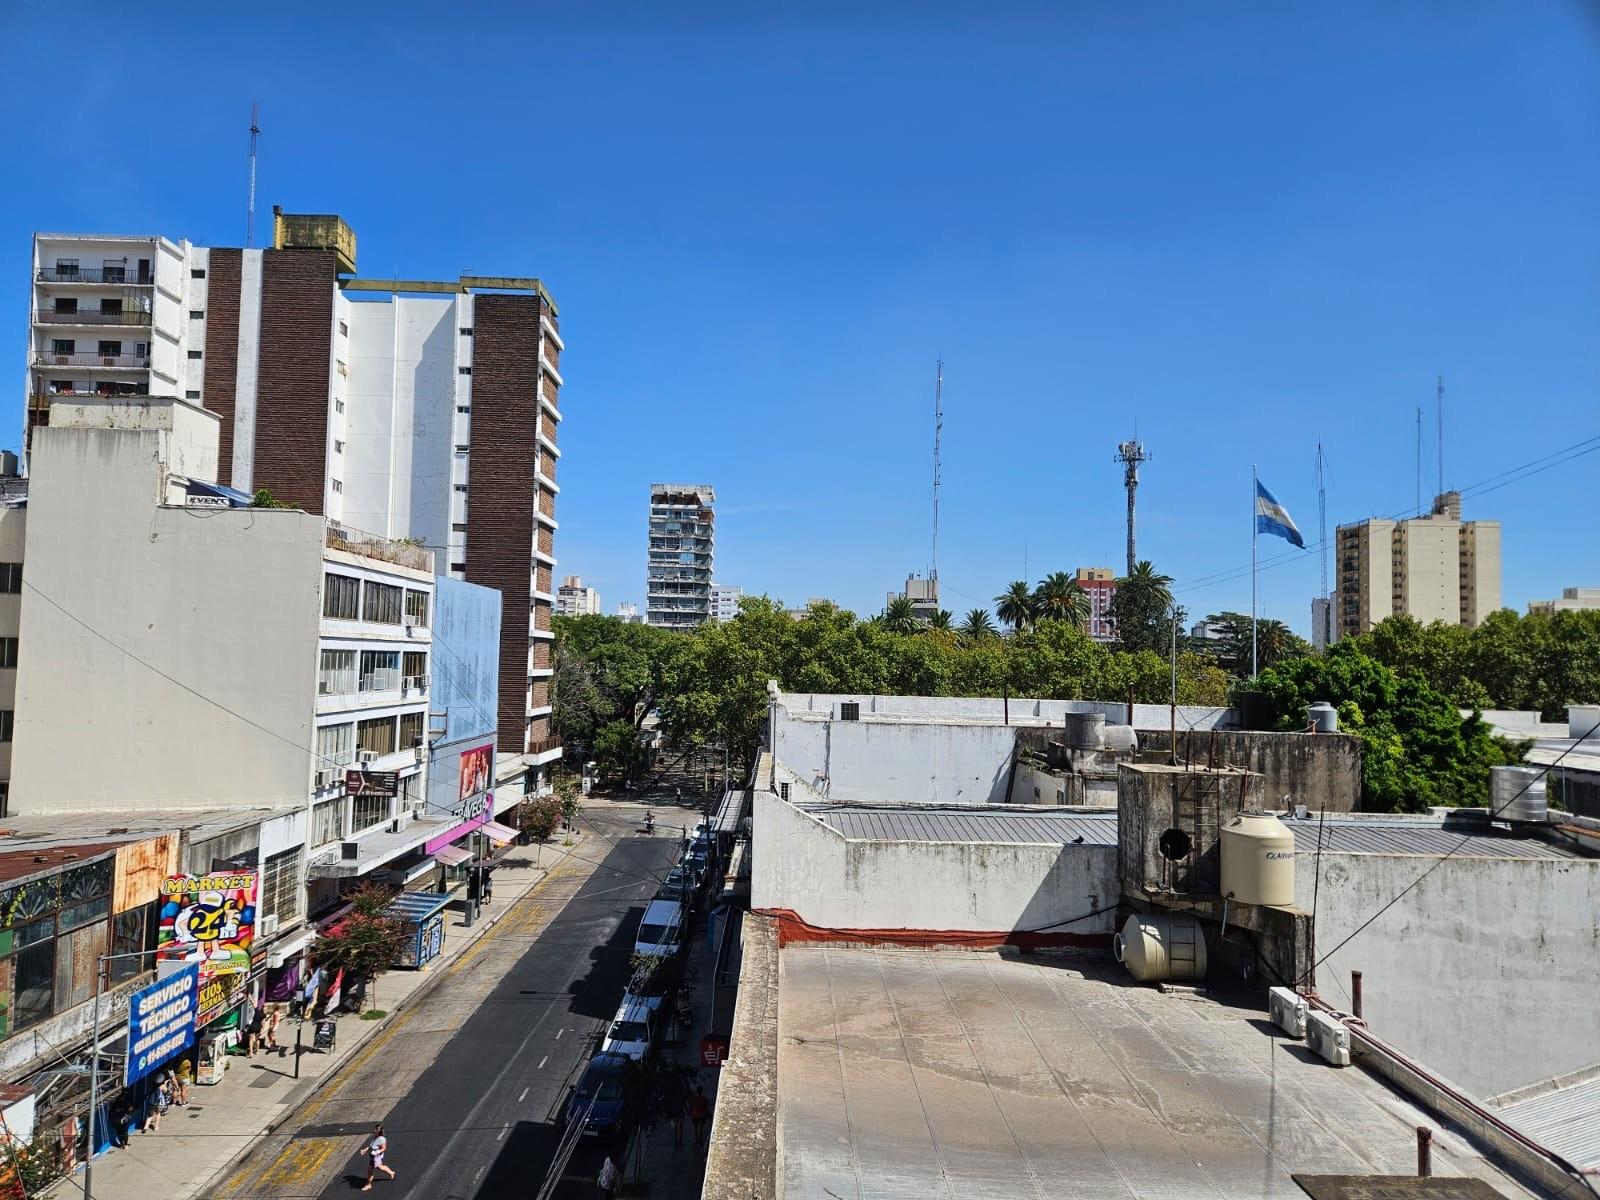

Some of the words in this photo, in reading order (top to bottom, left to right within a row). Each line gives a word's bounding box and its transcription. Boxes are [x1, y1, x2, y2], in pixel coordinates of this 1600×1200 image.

[165, 876, 253, 894] MARKET
[139, 975, 192, 1016] SERVICIO
[140, 995, 190, 1035] TÉCNICO
